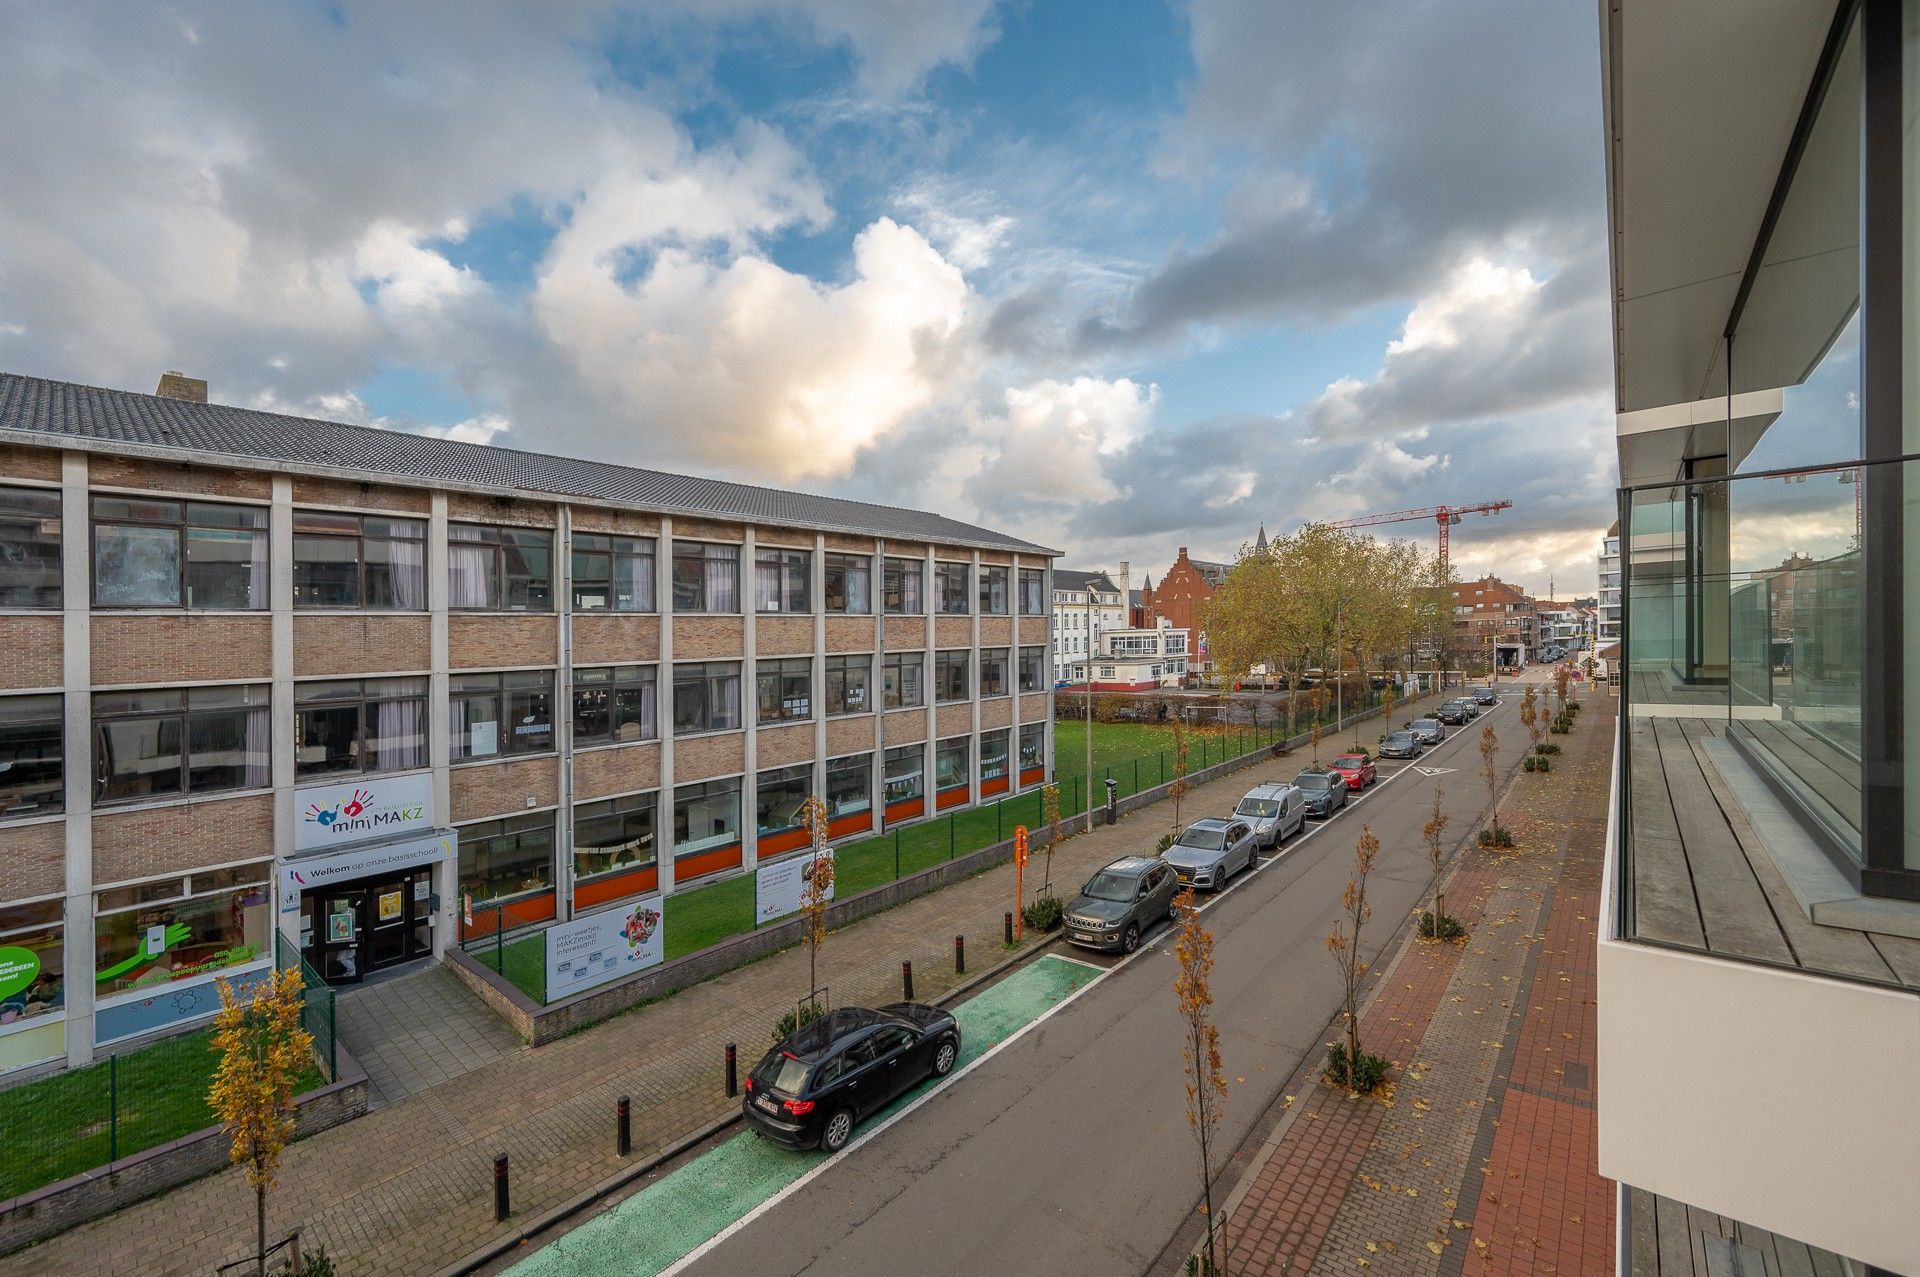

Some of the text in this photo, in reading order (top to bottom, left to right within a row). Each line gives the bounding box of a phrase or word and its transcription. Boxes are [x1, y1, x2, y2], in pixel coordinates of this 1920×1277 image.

[374, 807, 424, 826] MAKZ
[310, 847, 438, 878] Welkom op onze basisschool!
[556, 939, 597, 956] interessant!
